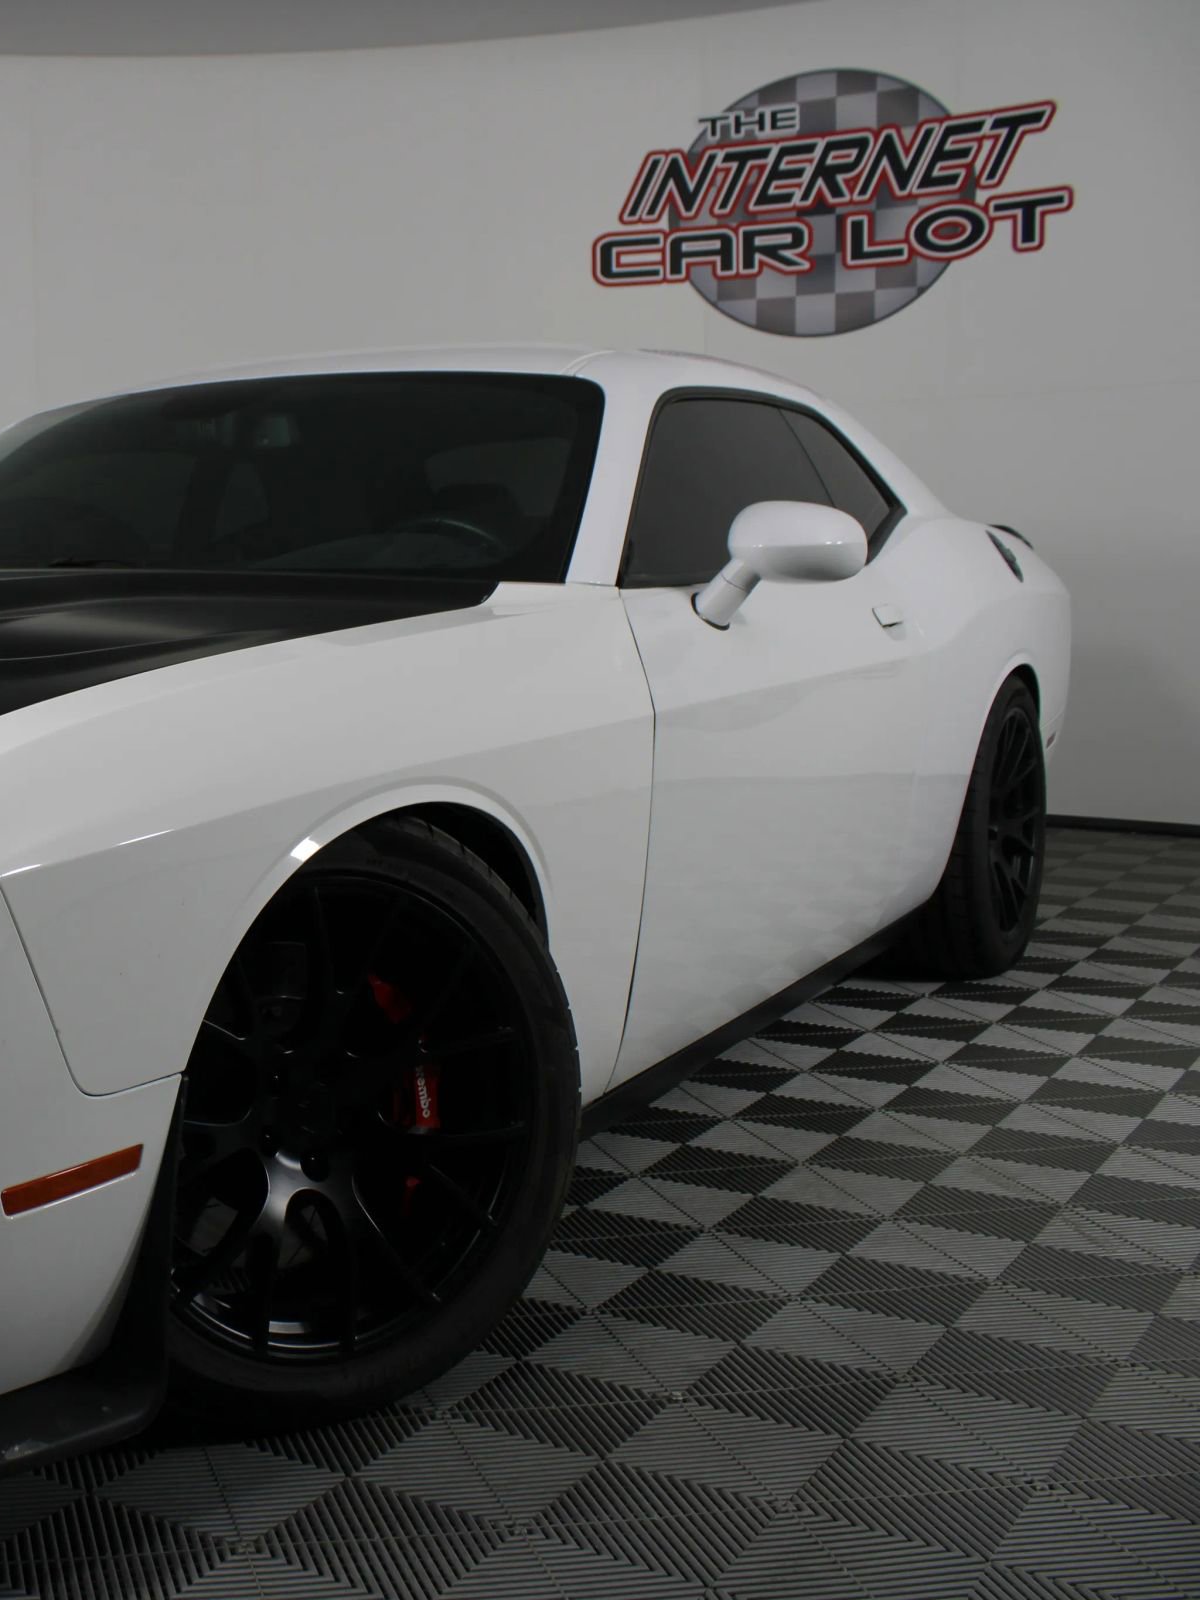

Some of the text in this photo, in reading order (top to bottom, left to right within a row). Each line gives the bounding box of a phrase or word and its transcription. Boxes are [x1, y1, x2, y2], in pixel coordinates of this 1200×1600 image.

[622, 102, 1054, 222] INTERNET
[697, 104, 799, 140] THE
[596, 189, 1071, 284] CAR LOT
